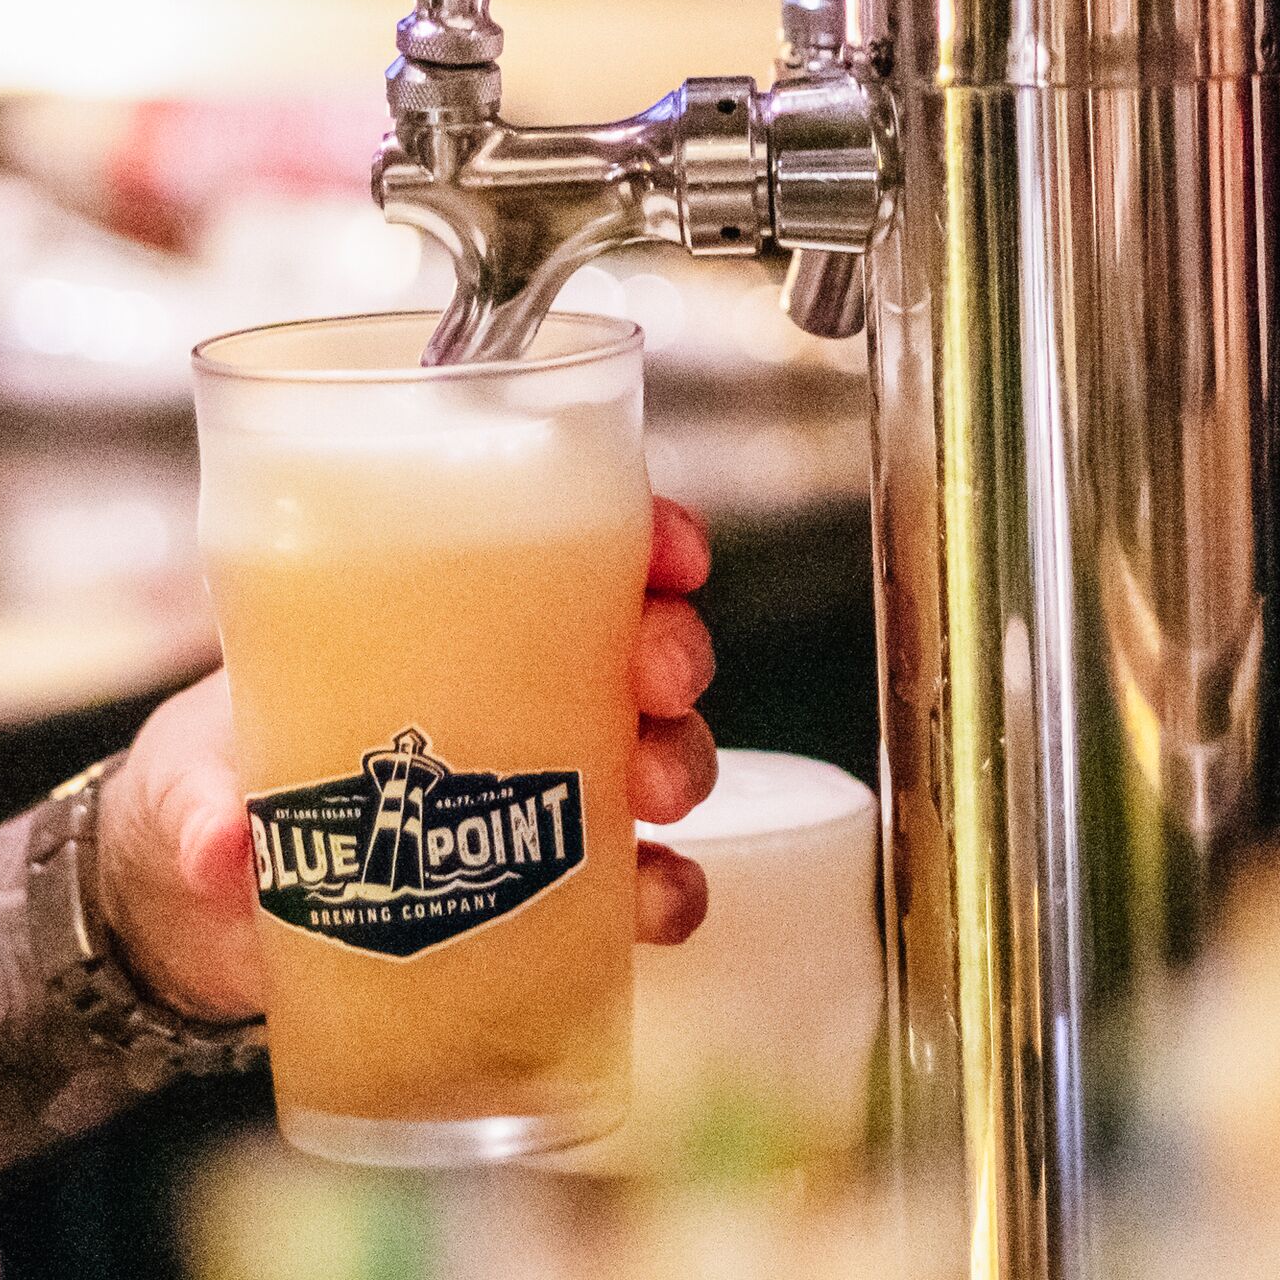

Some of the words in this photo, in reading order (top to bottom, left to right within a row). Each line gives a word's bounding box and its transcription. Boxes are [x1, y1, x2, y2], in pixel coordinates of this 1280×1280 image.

[321, 807, 361, 820] ISLAND
[250, 812, 359, 891] BLUE
[427, 782, 568, 867] POINT
[310, 906, 391, 925] BREWING
[402, 892, 497, 921] COMPANY
